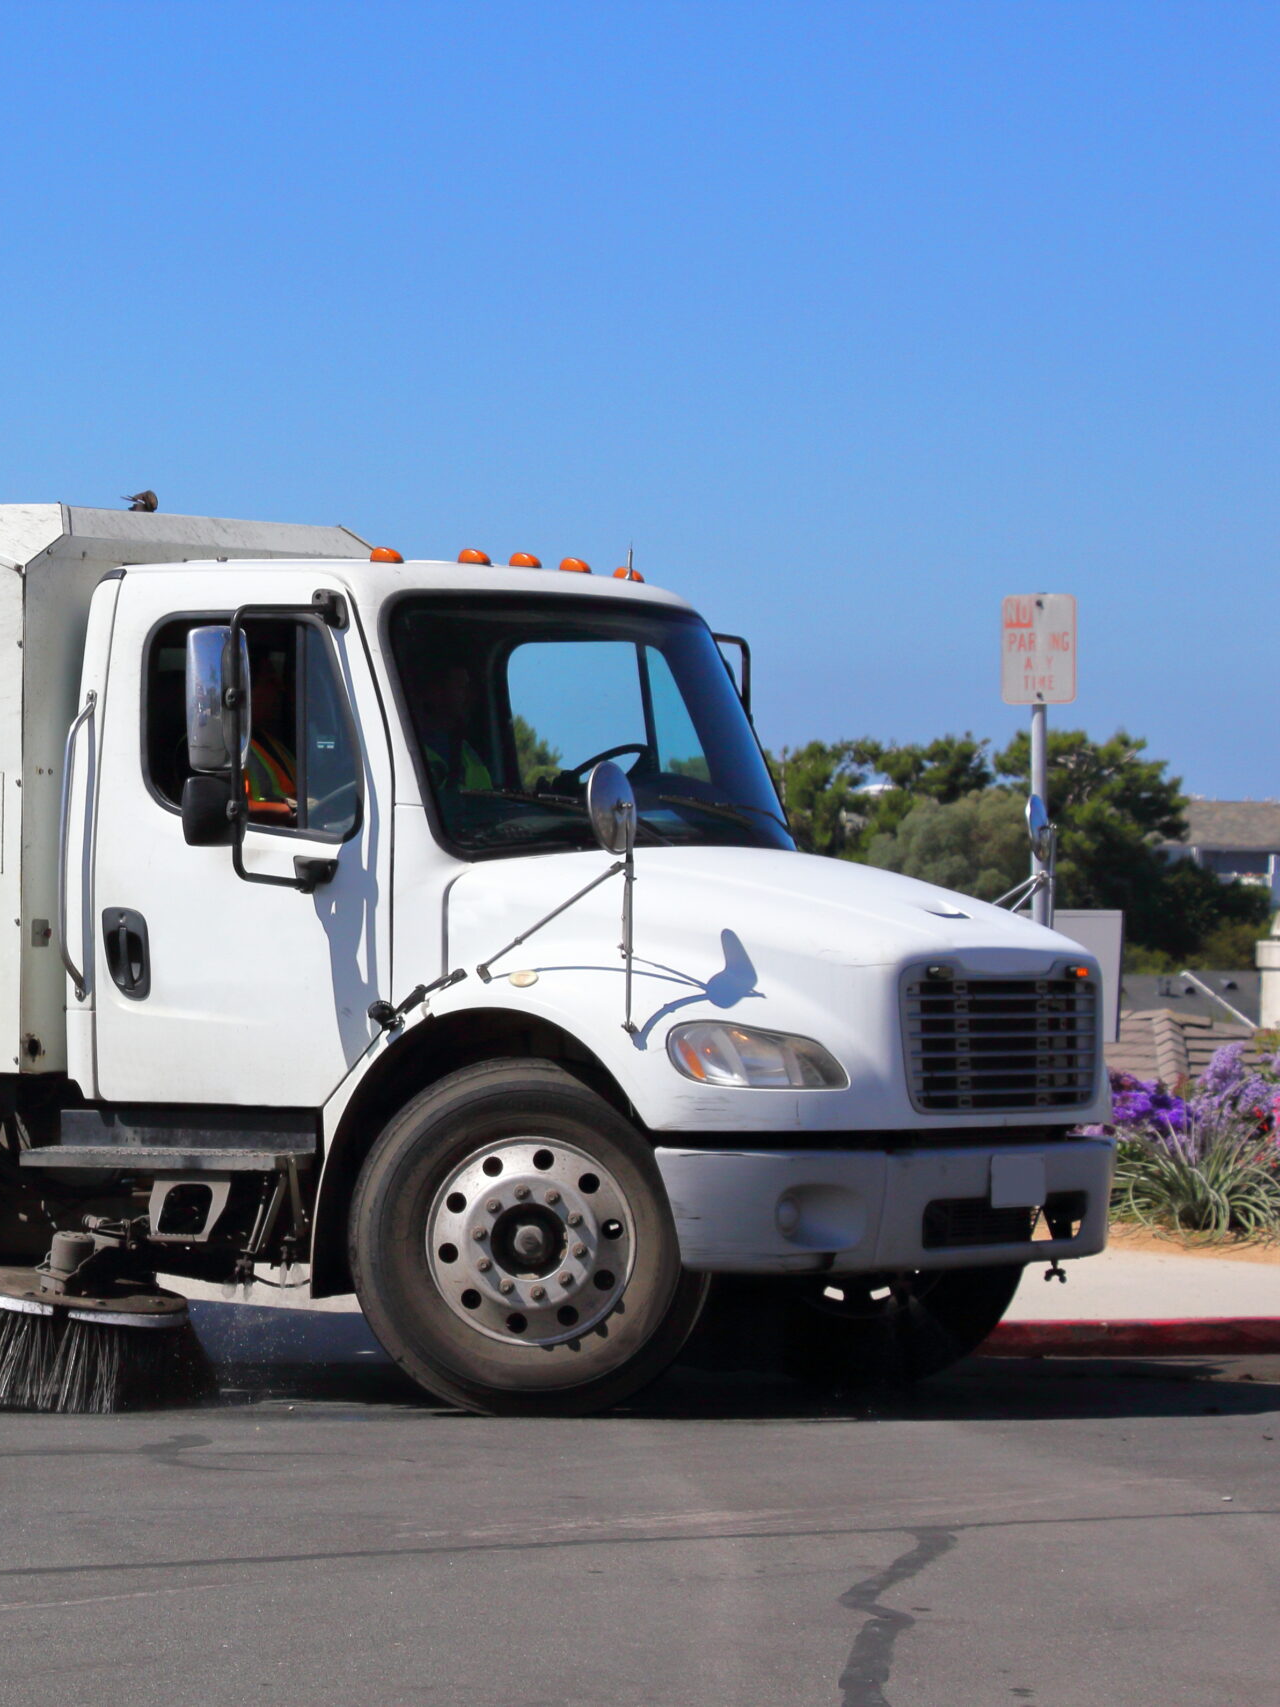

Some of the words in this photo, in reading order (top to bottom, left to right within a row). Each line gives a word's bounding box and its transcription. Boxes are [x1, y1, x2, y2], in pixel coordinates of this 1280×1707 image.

[1008, 632, 1070, 652] PARING
[1024, 656, 1054, 671] AY
[1024, 675, 1055, 691] TIME
